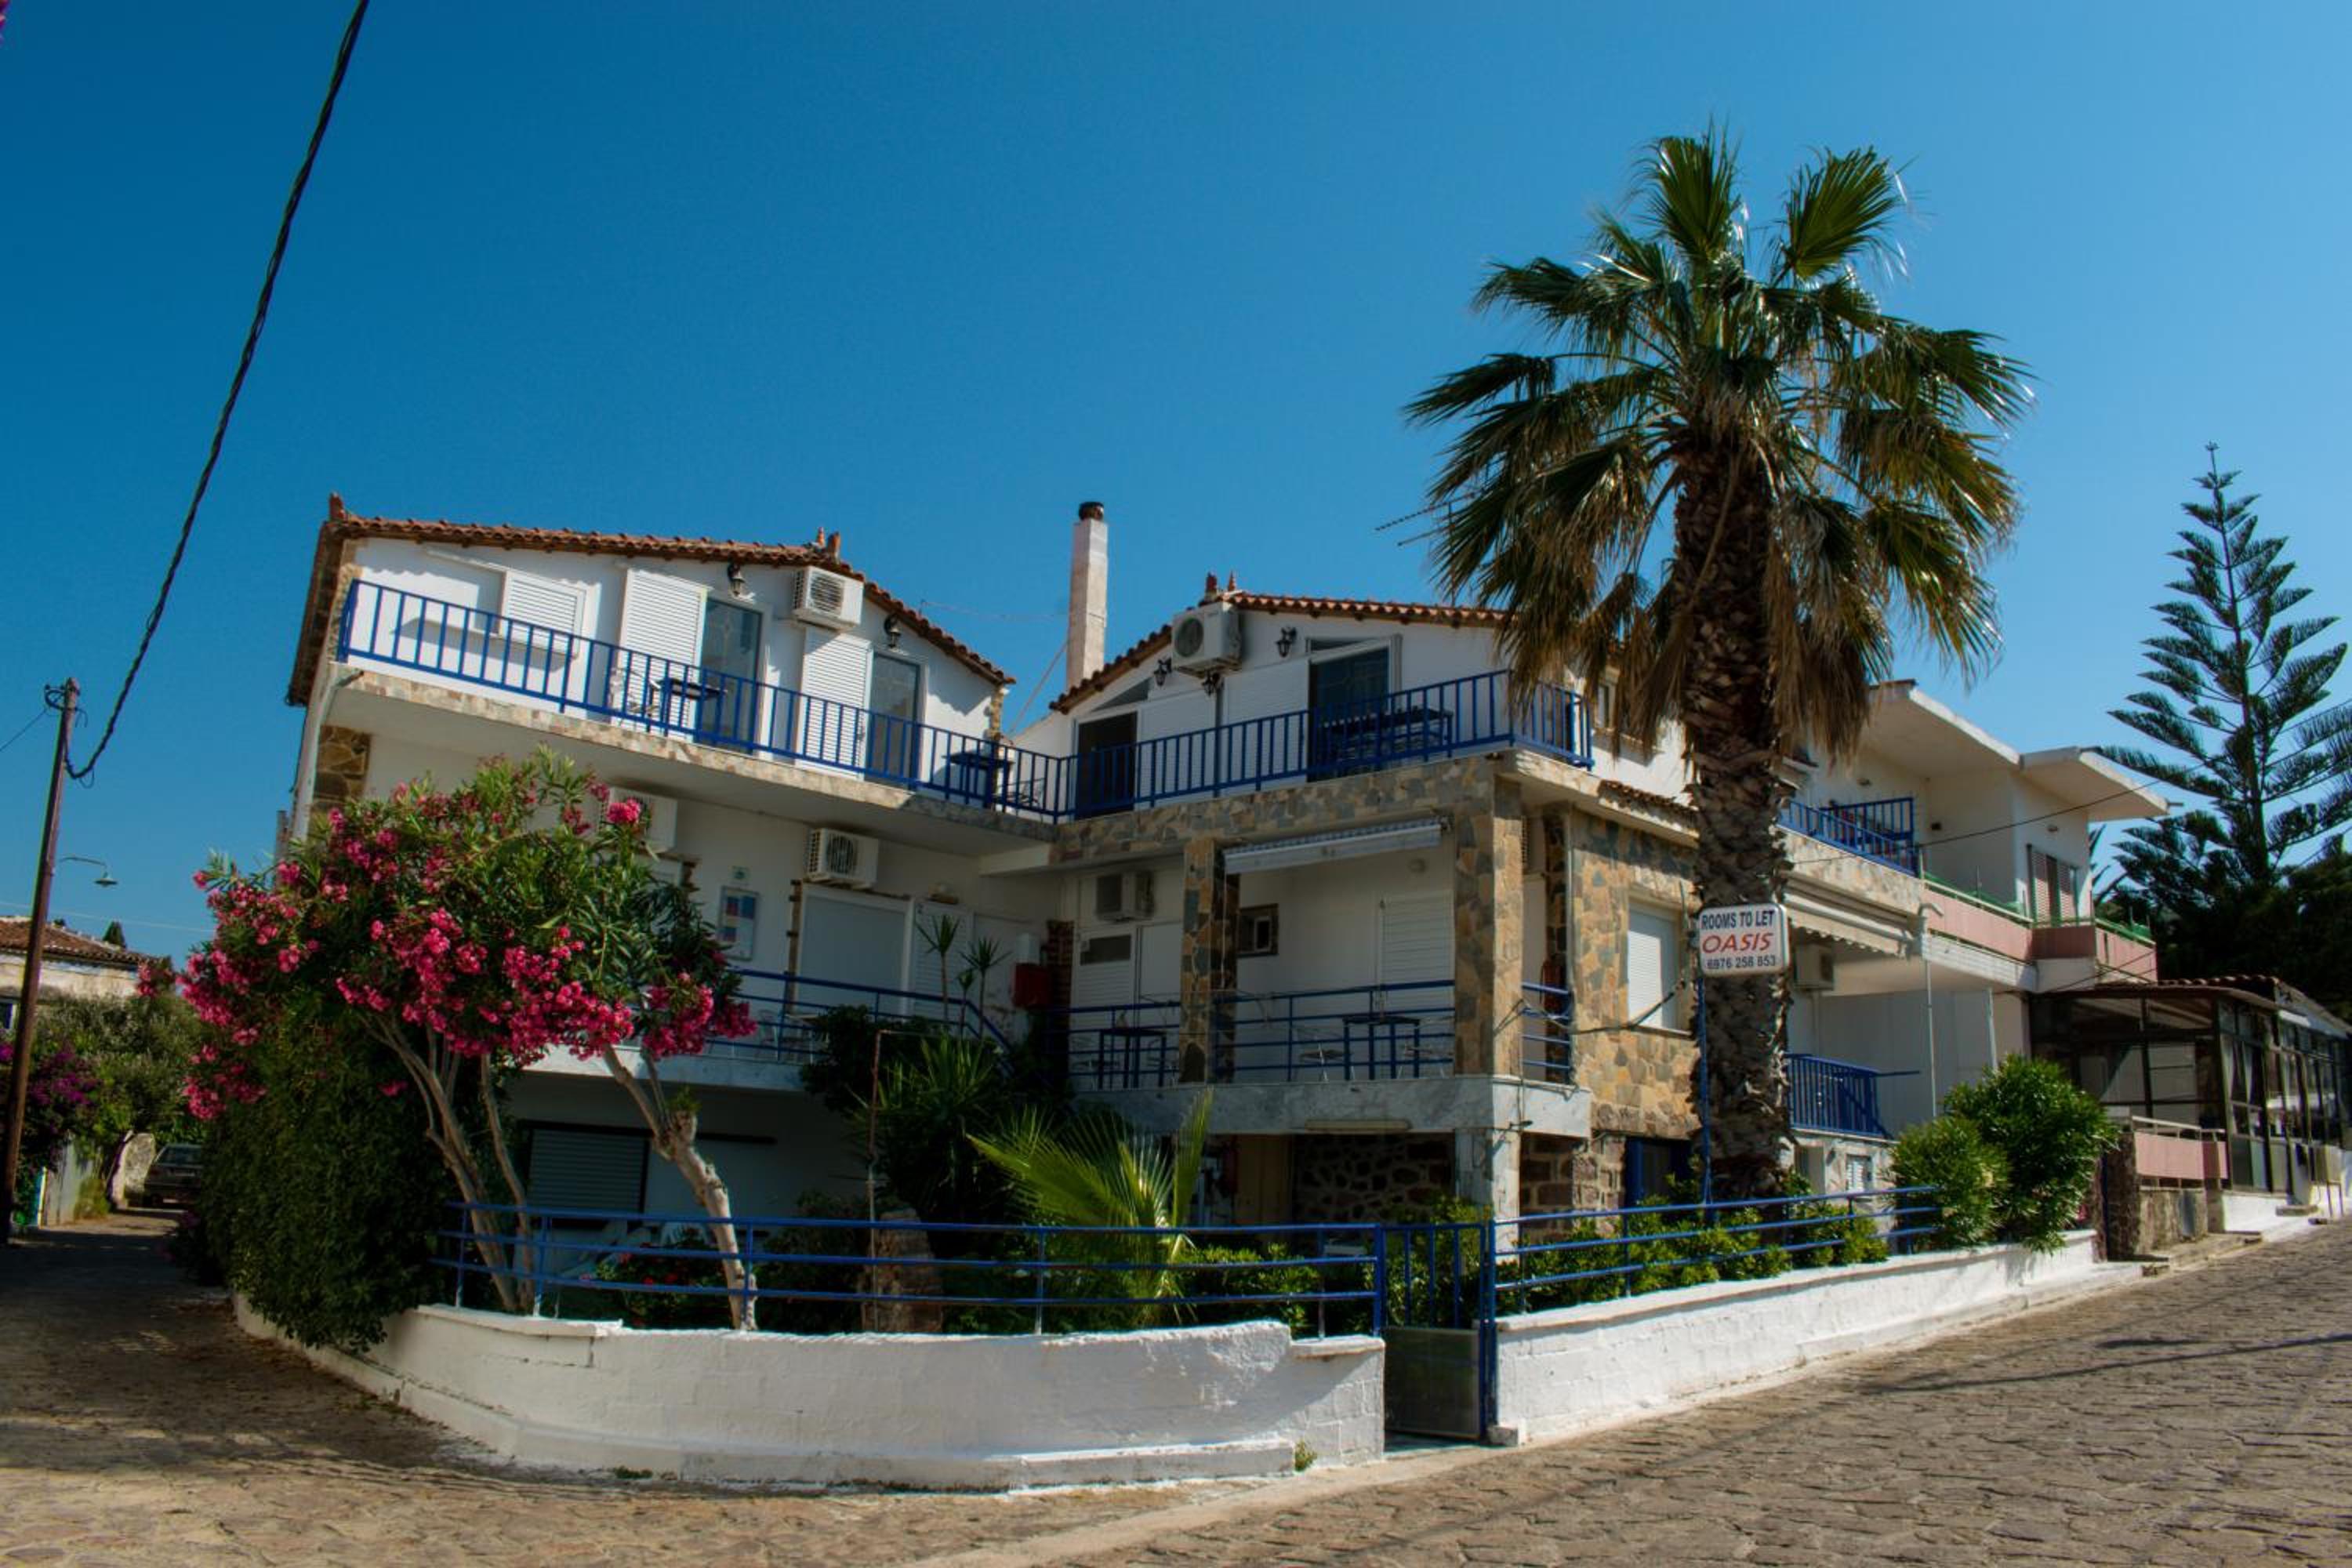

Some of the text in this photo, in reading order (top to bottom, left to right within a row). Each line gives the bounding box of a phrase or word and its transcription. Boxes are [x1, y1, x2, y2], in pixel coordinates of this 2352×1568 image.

[1702, 909, 1775, 930] ROOMS TO LET
[1702, 933, 1773, 953] OASIS
